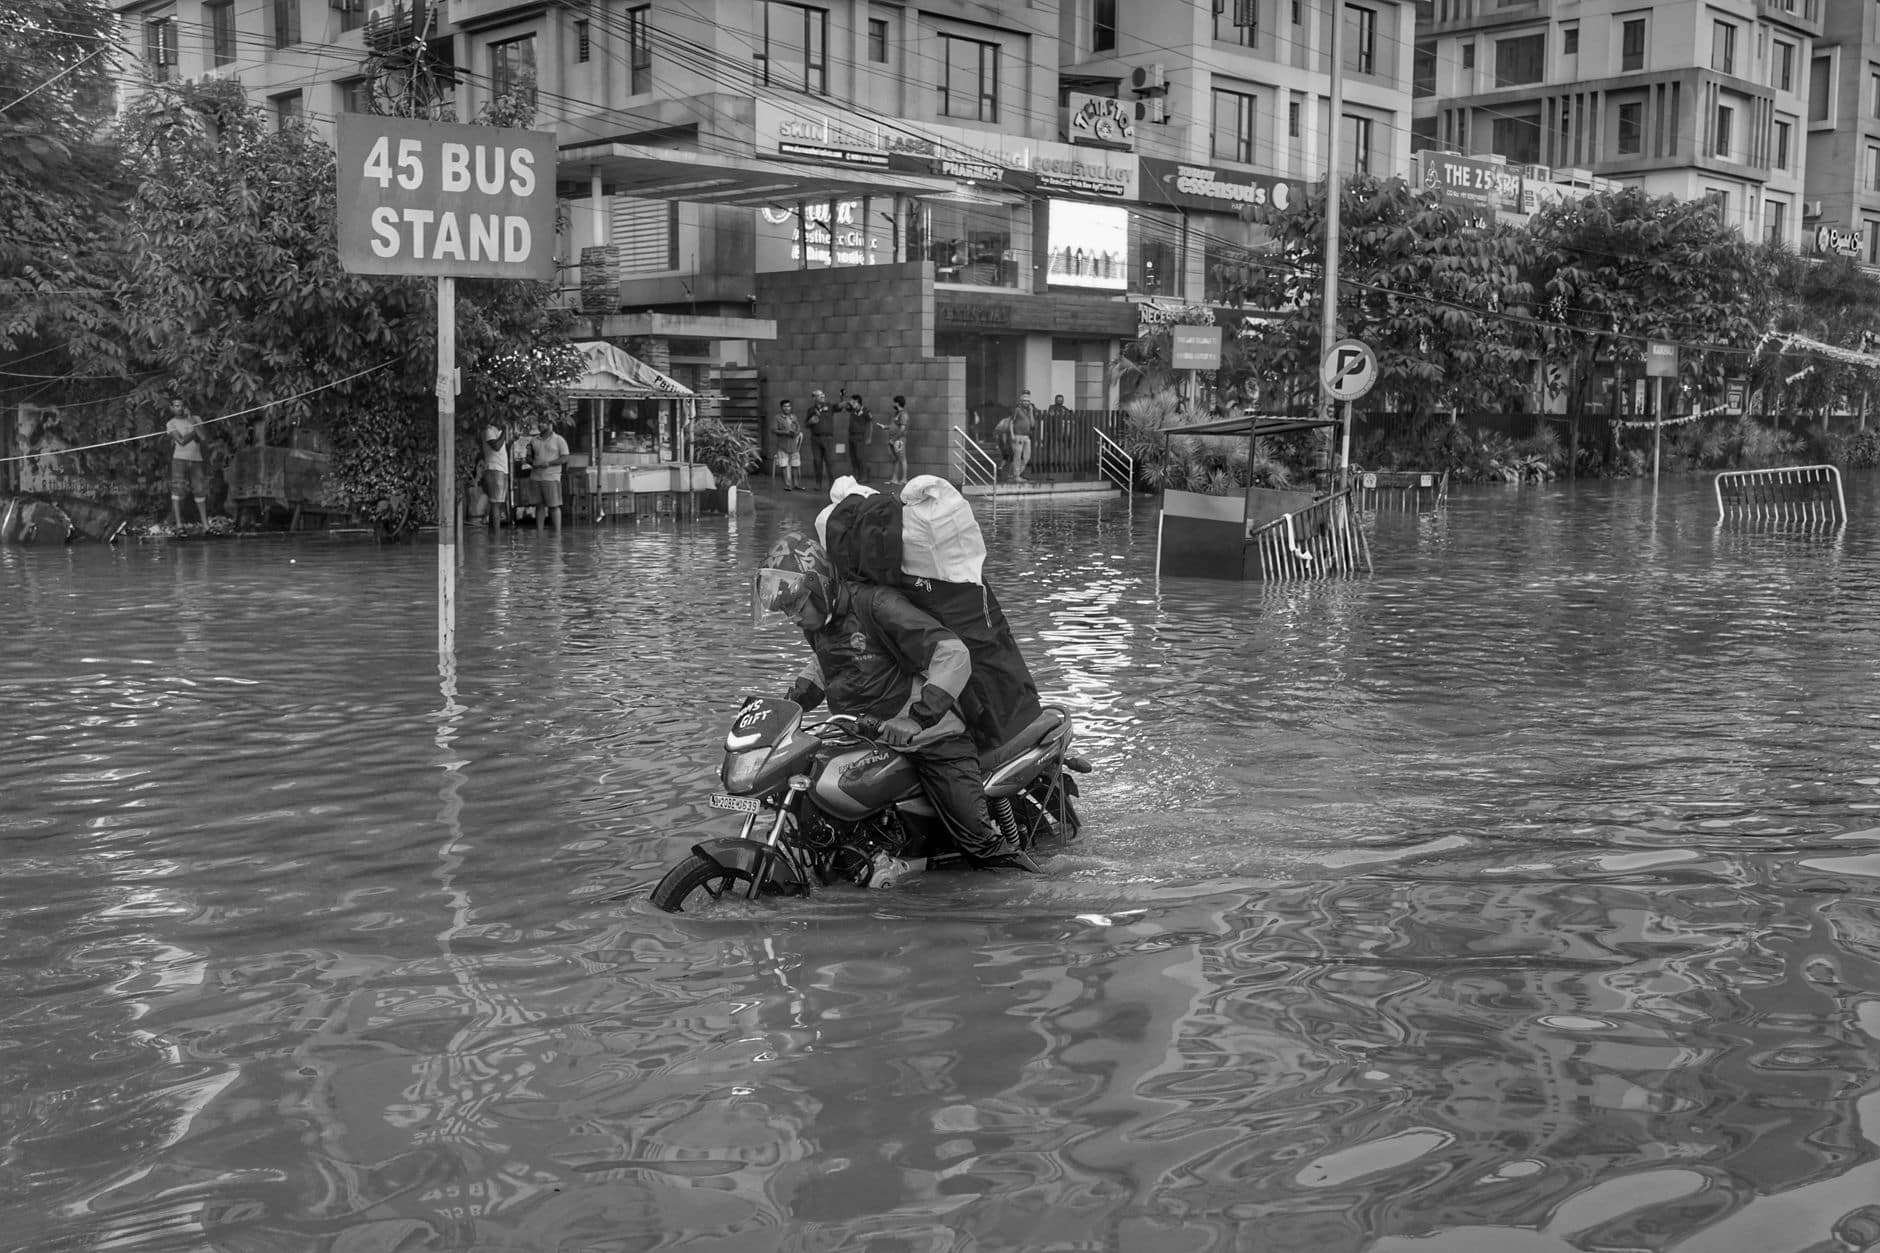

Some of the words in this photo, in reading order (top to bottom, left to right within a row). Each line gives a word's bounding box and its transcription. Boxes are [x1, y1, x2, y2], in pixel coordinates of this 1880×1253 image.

[364, 136, 424, 190] 45
[441, 142, 536, 198] BUS
[942, 161, 1004, 181] PHARMACY
[1031, 157, 1134, 182] COSMETOLOGY
[1444, 163, 1471, 187] THE
[1475, 168, 1491, 190] 25
[371, 207, 531, 263] STAND
[1335, 350, 1366, 389] P
[739, 709, 772, 729] GIFT
